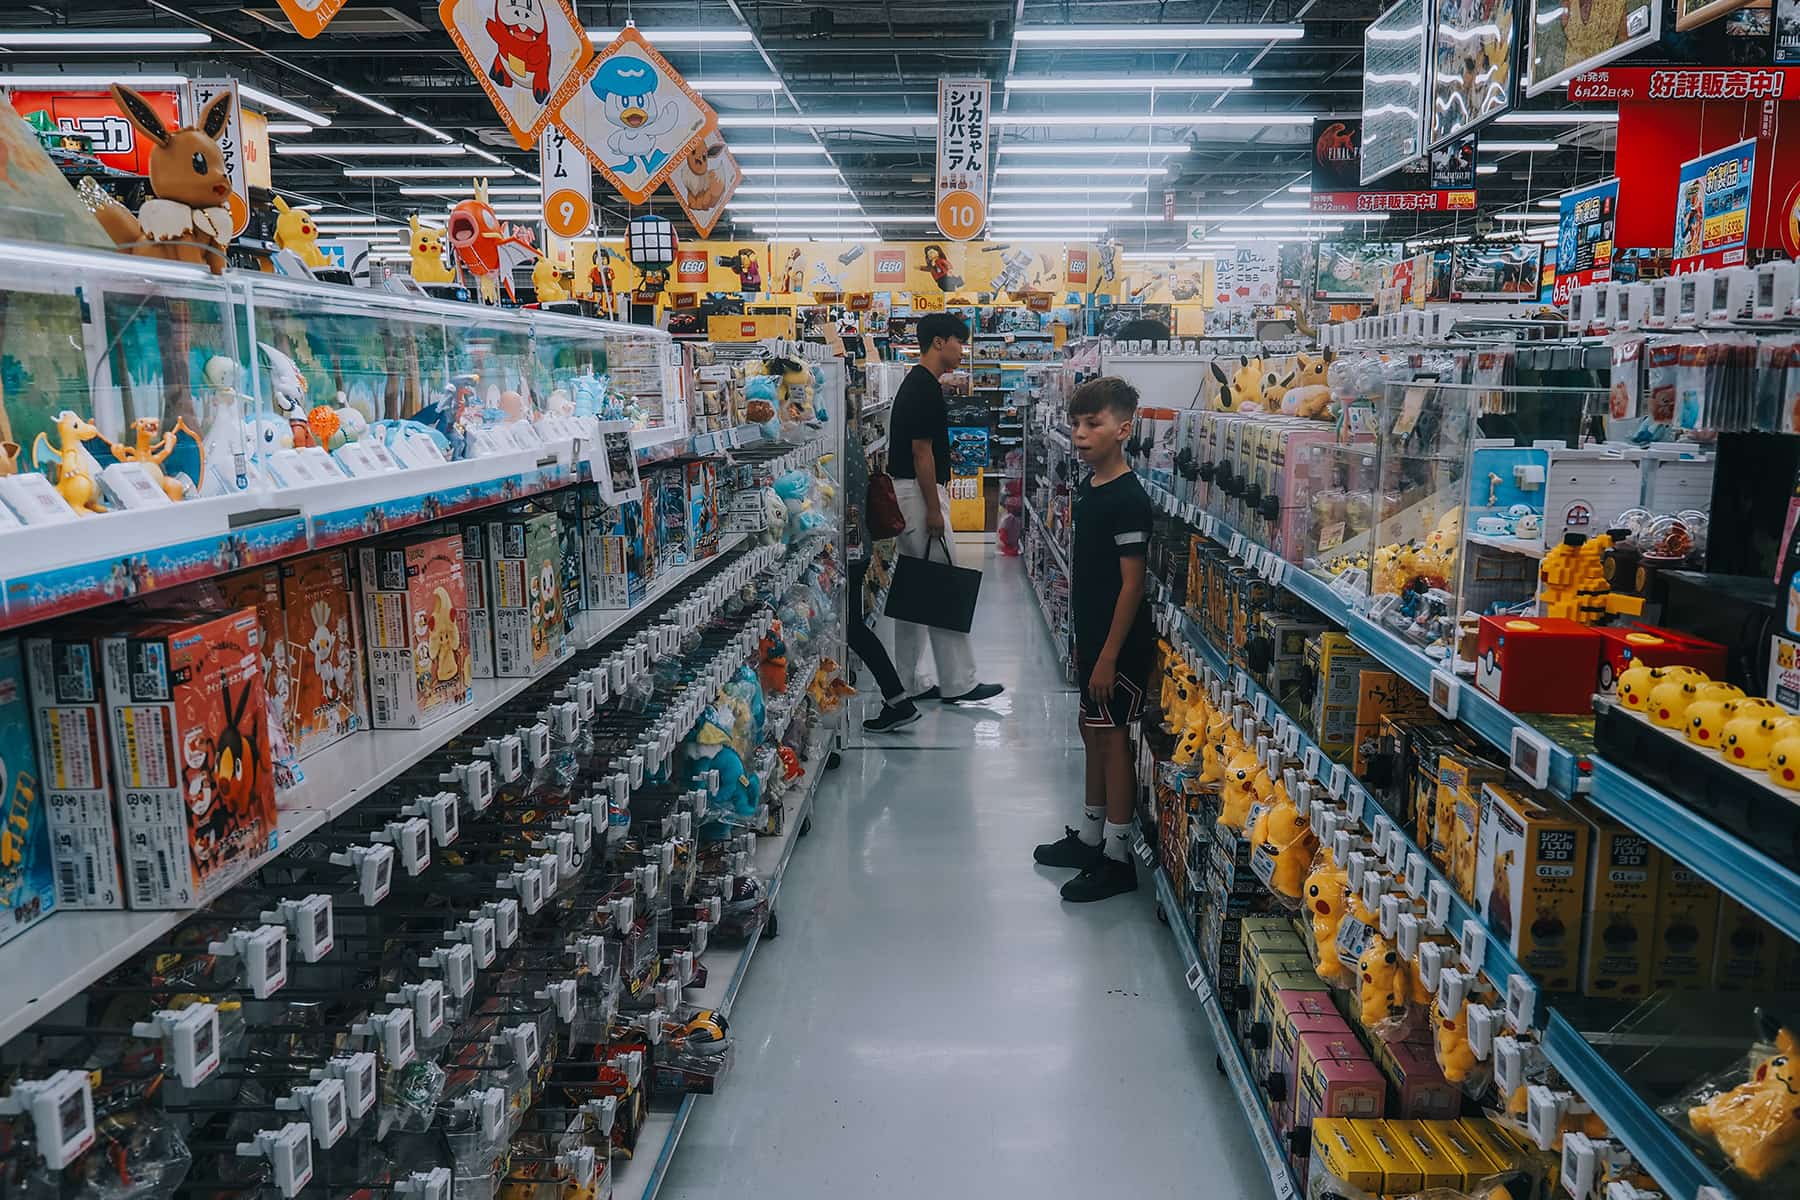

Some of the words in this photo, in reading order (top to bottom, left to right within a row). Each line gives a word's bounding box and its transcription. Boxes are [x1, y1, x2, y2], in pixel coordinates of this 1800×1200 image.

[450, 28, 461, 46] ALL
[461, 45, 480, 72] STAR
[475, 71, 513, 127] COLLECTION
[1649, 70, 1785, 98] 好評販売中!
[1574, 84, 1634, 97] 6月22日(木)
[530, 124, 541, 141] ALL
[540, 109, 553, 128] STAR
[551, 67, 581, 110] COLLECTION
[948, 90, 966, 170] シルバニア
[966, 90, 983, 171] リカちゃん
[556, 123, 570, 138] ALL
[568, 135, 587, 155] STAR
[586, 151, 622, 191] COLLECTION
[643, 185, 654, 198] ALL
[653, 170, 668, 188] STAR
[666, 135, 702, 174] COLLECTION
[559, 201, 574, 226] 9
[1357, 194, 1438, 213] 好評販売中!
[949, 205, 975, 227] 10
[680, 260, 706, 274] LEGO
[877, 259, 904, 273] LEGO
[1070, 259, 1085, 273] LEGO
[1544, 851, 1568, 860] 3D
[1618, 856, 1641, 865] 3D
